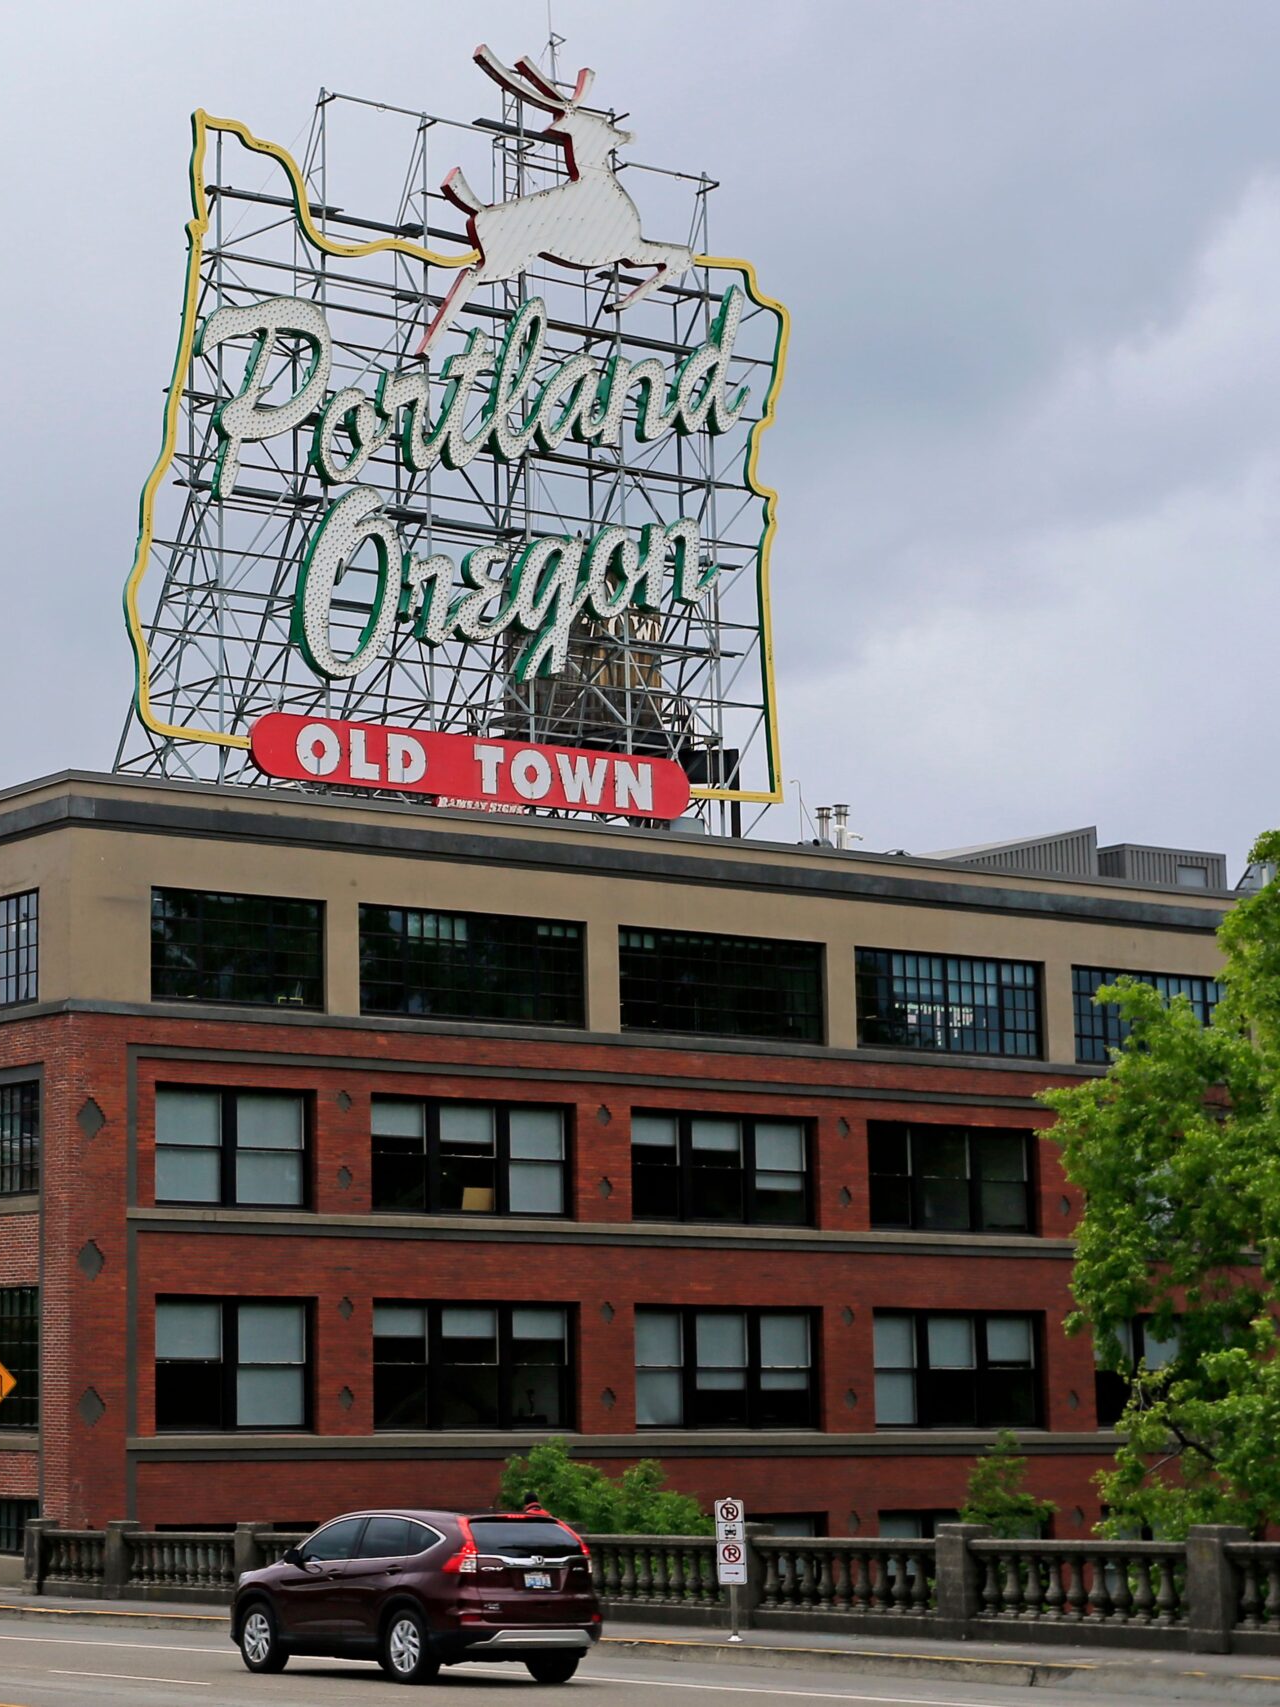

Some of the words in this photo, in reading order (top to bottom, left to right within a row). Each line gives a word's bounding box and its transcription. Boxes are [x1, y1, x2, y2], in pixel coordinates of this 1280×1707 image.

[193, 283, 751, 500] Portland
[293, 485, 720, 681] Oregon
[295, 722, 427, 784] OLD
[473, 743, 654, 812] TOWN
[437, 796, 488, 811] RAMSAY
